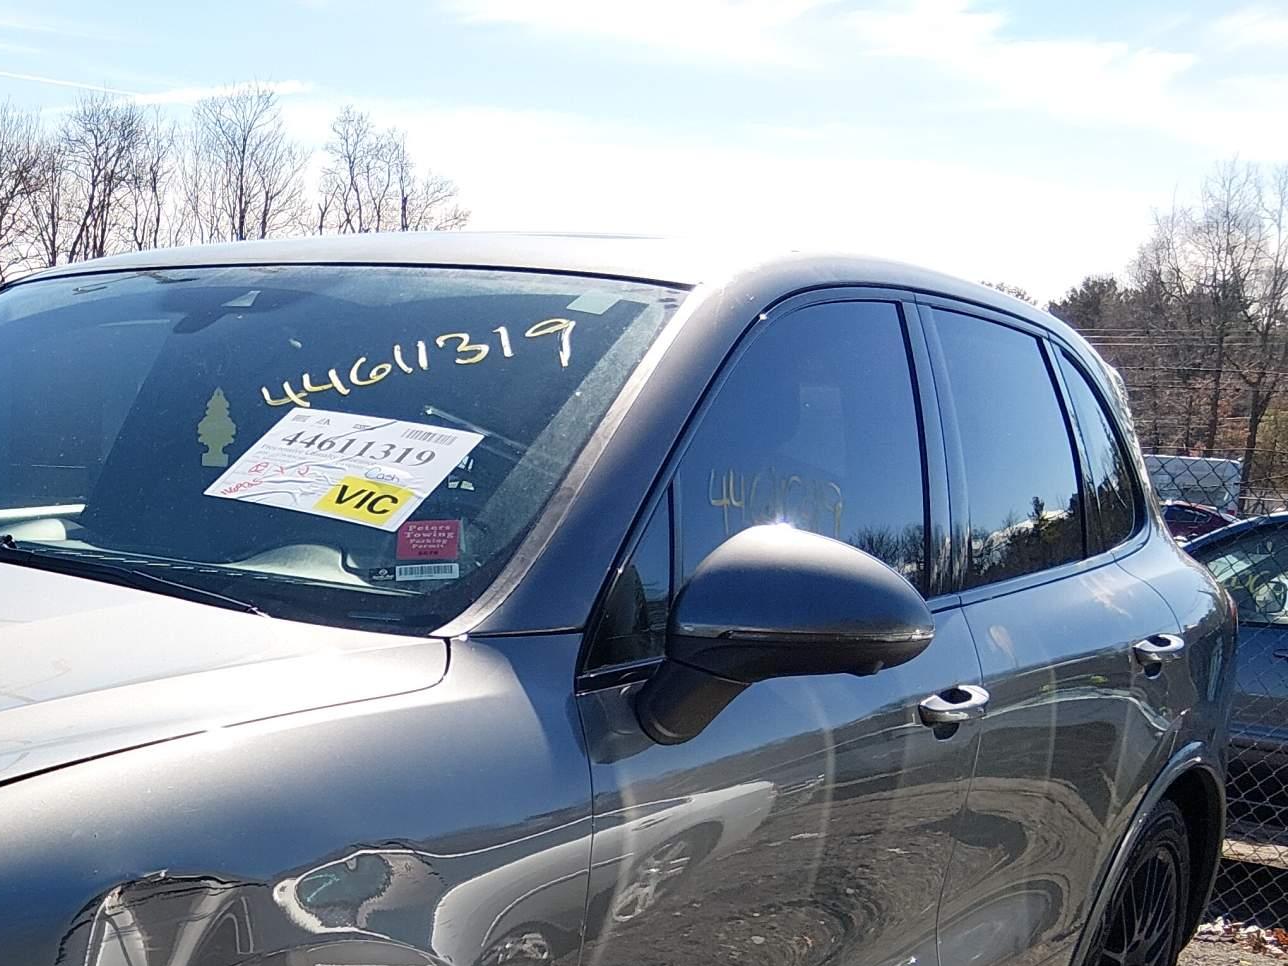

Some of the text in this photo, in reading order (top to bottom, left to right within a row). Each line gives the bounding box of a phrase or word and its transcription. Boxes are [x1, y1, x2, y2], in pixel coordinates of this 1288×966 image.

[261, 317, 576, 408] 44611319
[282, 430, 436, 467] 44611319
[335, 484, 398, 515] VIC
